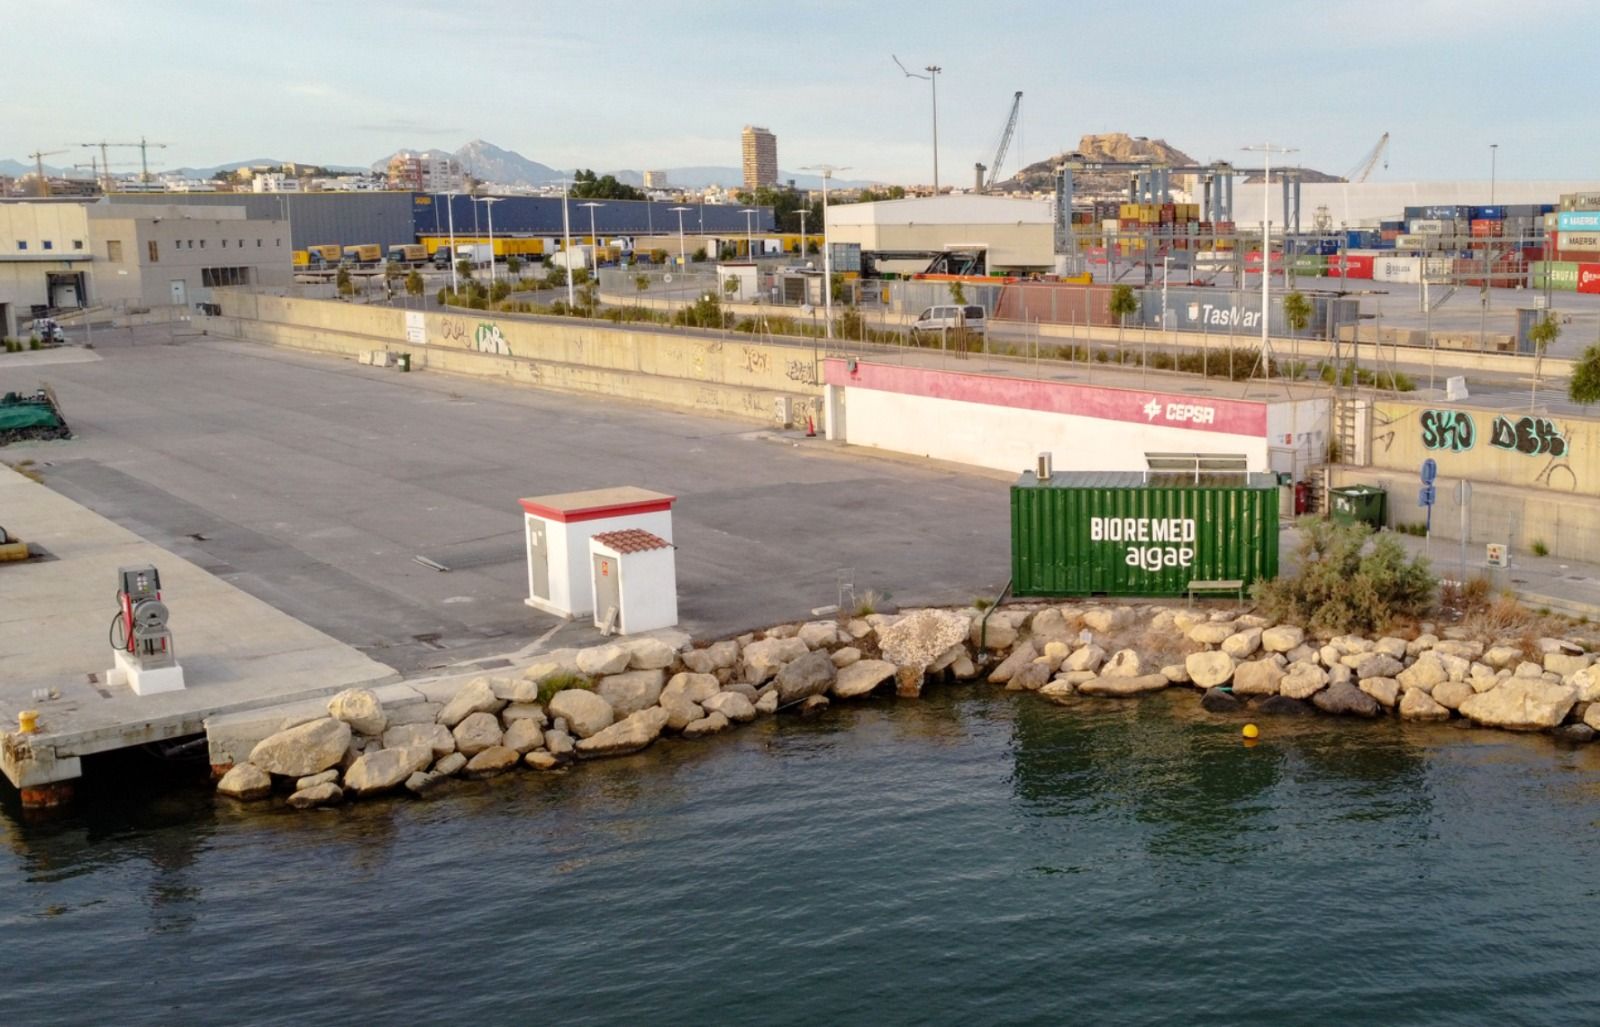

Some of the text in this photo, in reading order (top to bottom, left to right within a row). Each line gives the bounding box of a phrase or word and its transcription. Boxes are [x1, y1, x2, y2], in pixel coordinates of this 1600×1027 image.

[1570, 216, 1598, 226] MAERSK
[1569, 237, 1597, 246] MAERSK
[1203, 304, 1261, 327] TasMar
[1166, 403, 1215, 424] CEPSA
[1125, 546, 1193, 572] algae
